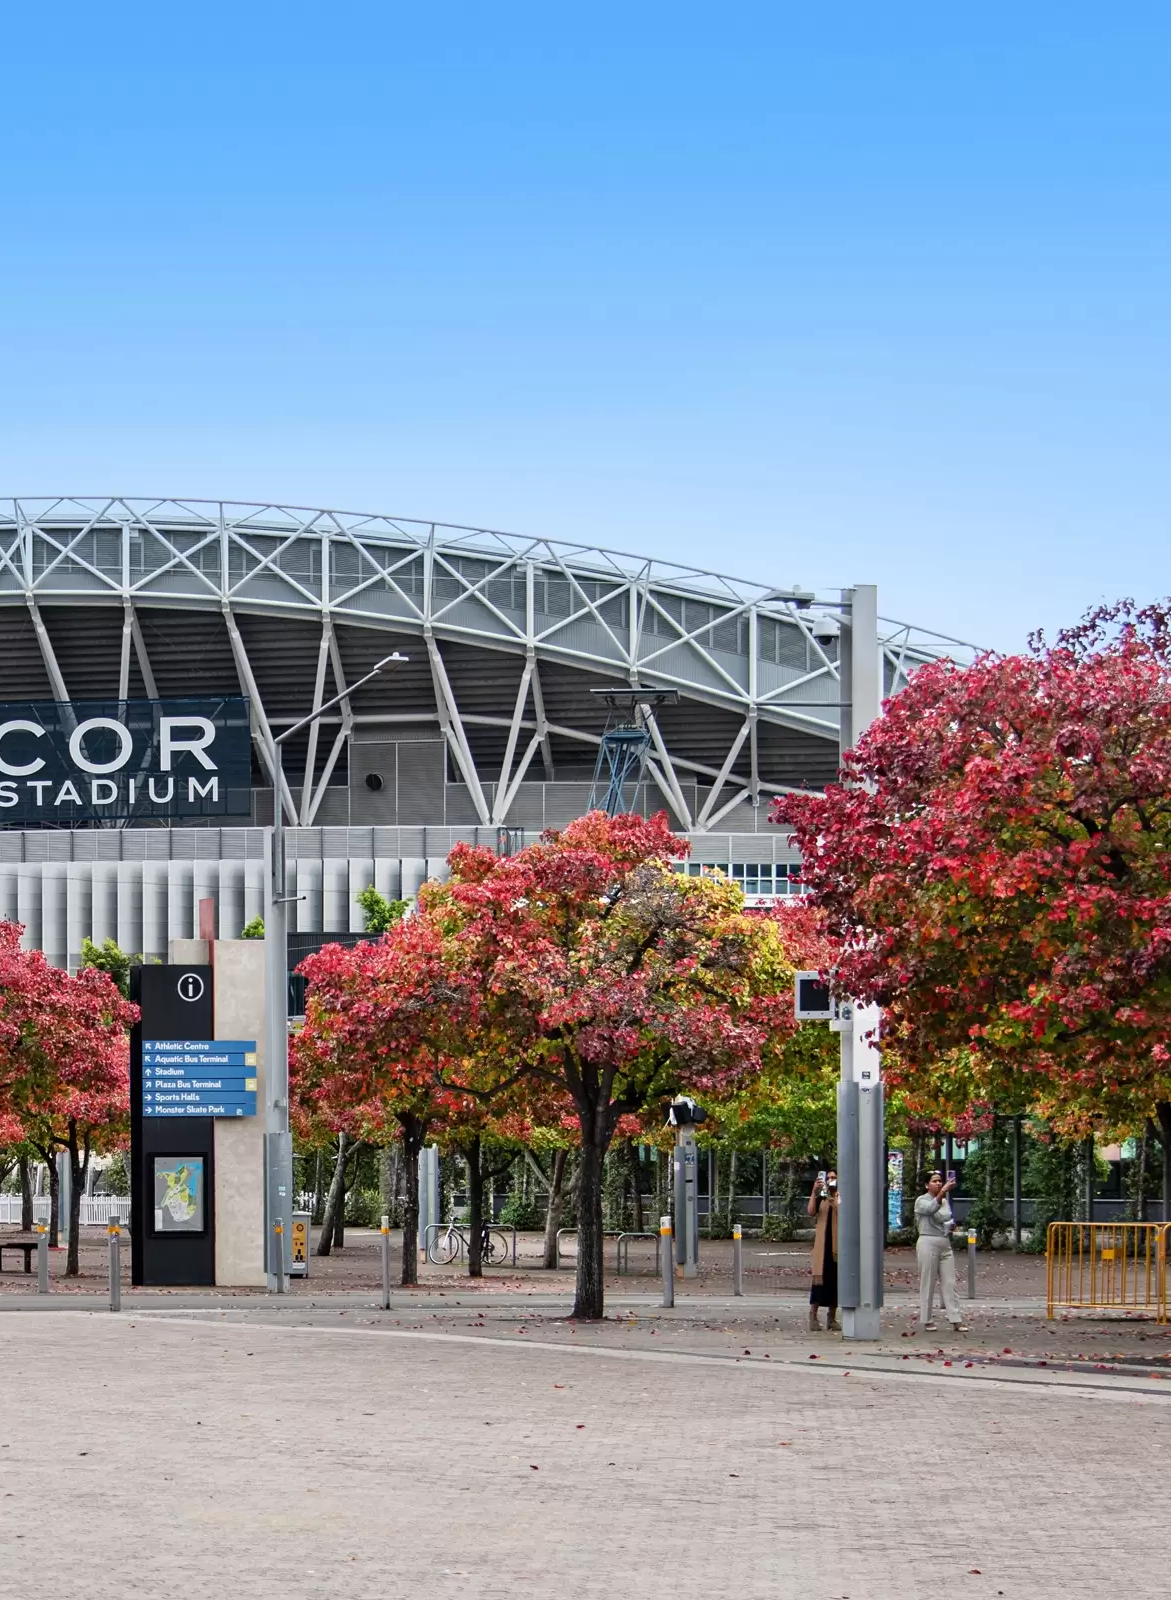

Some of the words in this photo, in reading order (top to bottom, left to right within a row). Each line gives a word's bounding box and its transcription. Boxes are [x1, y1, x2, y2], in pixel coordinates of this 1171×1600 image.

[155, 1042, 183, 1050] Athletic
[184, 1042, 209, 1050] Centre
[155, 1055, 183, 1064] Aquatic
[185, 1055, 198, 1063] Bus
[199, 1055, 228, 1063] Terminal
[155, 1067, 184, 1075] Stadium
[155, 1093, 179, 1102] Sports
[181, 1093, 199, 1101] Halls
